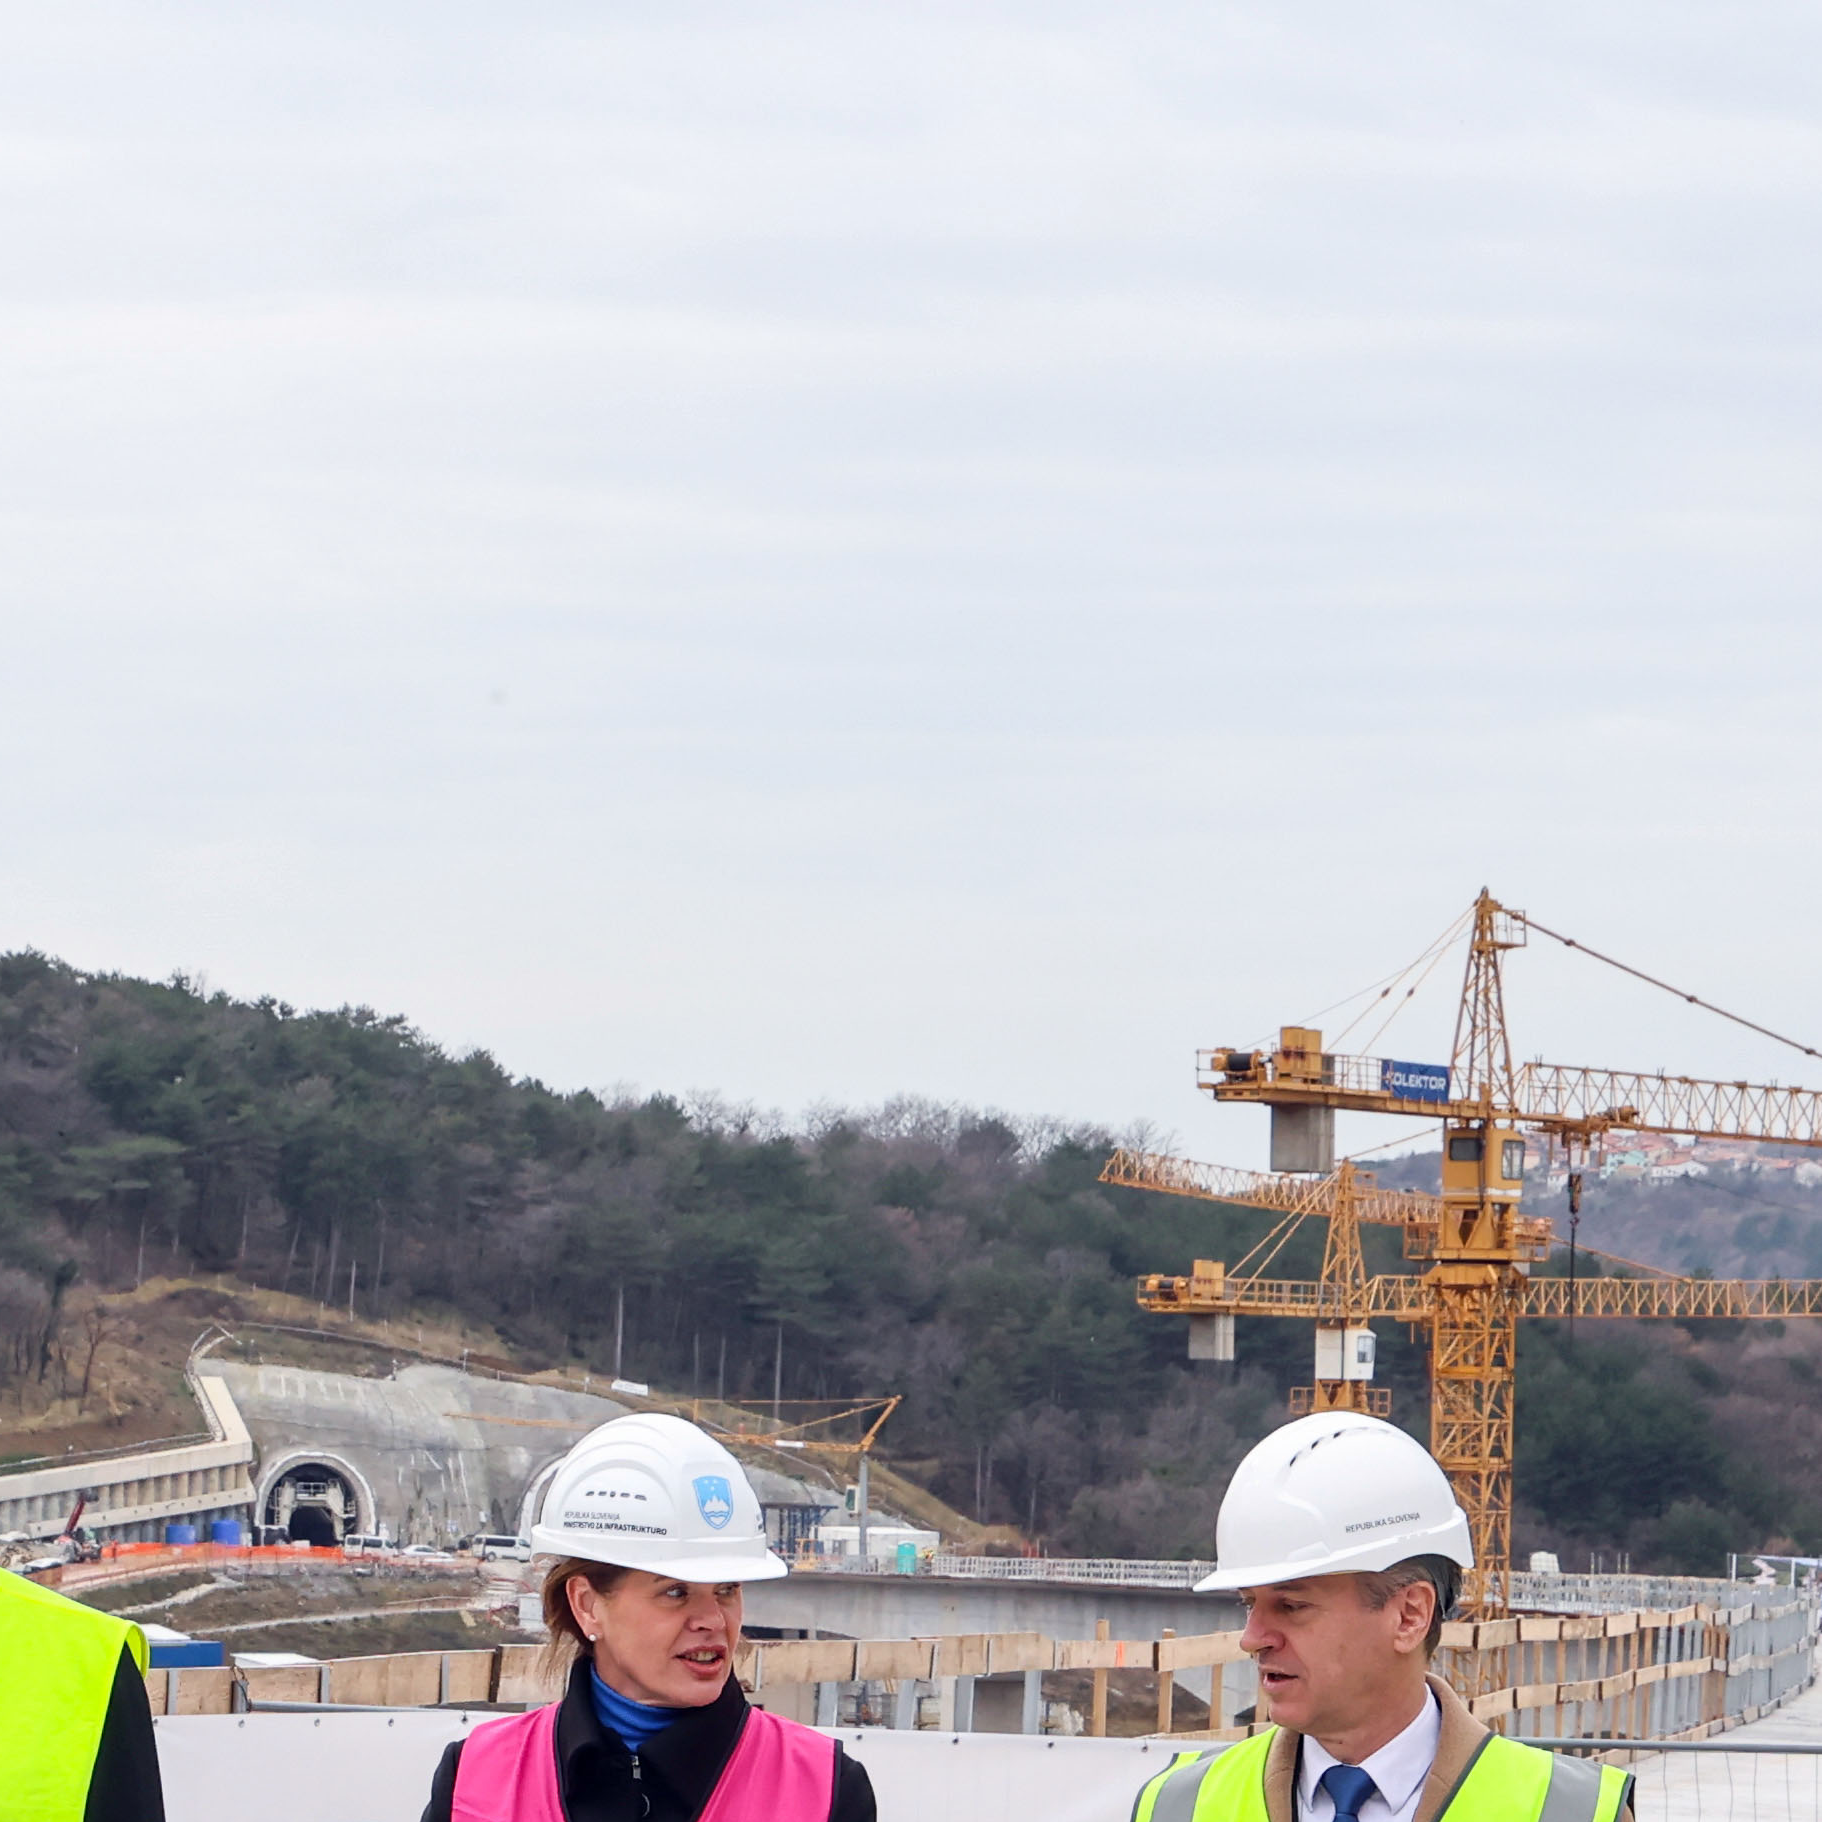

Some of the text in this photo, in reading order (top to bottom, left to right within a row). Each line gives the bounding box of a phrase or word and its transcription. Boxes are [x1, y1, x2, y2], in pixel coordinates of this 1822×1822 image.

[604, 1523, 667, 1536] INFRASTRUKTURO
[1345, 1512, 1420, 1533] REPUBLIKA SLOVENIJA
